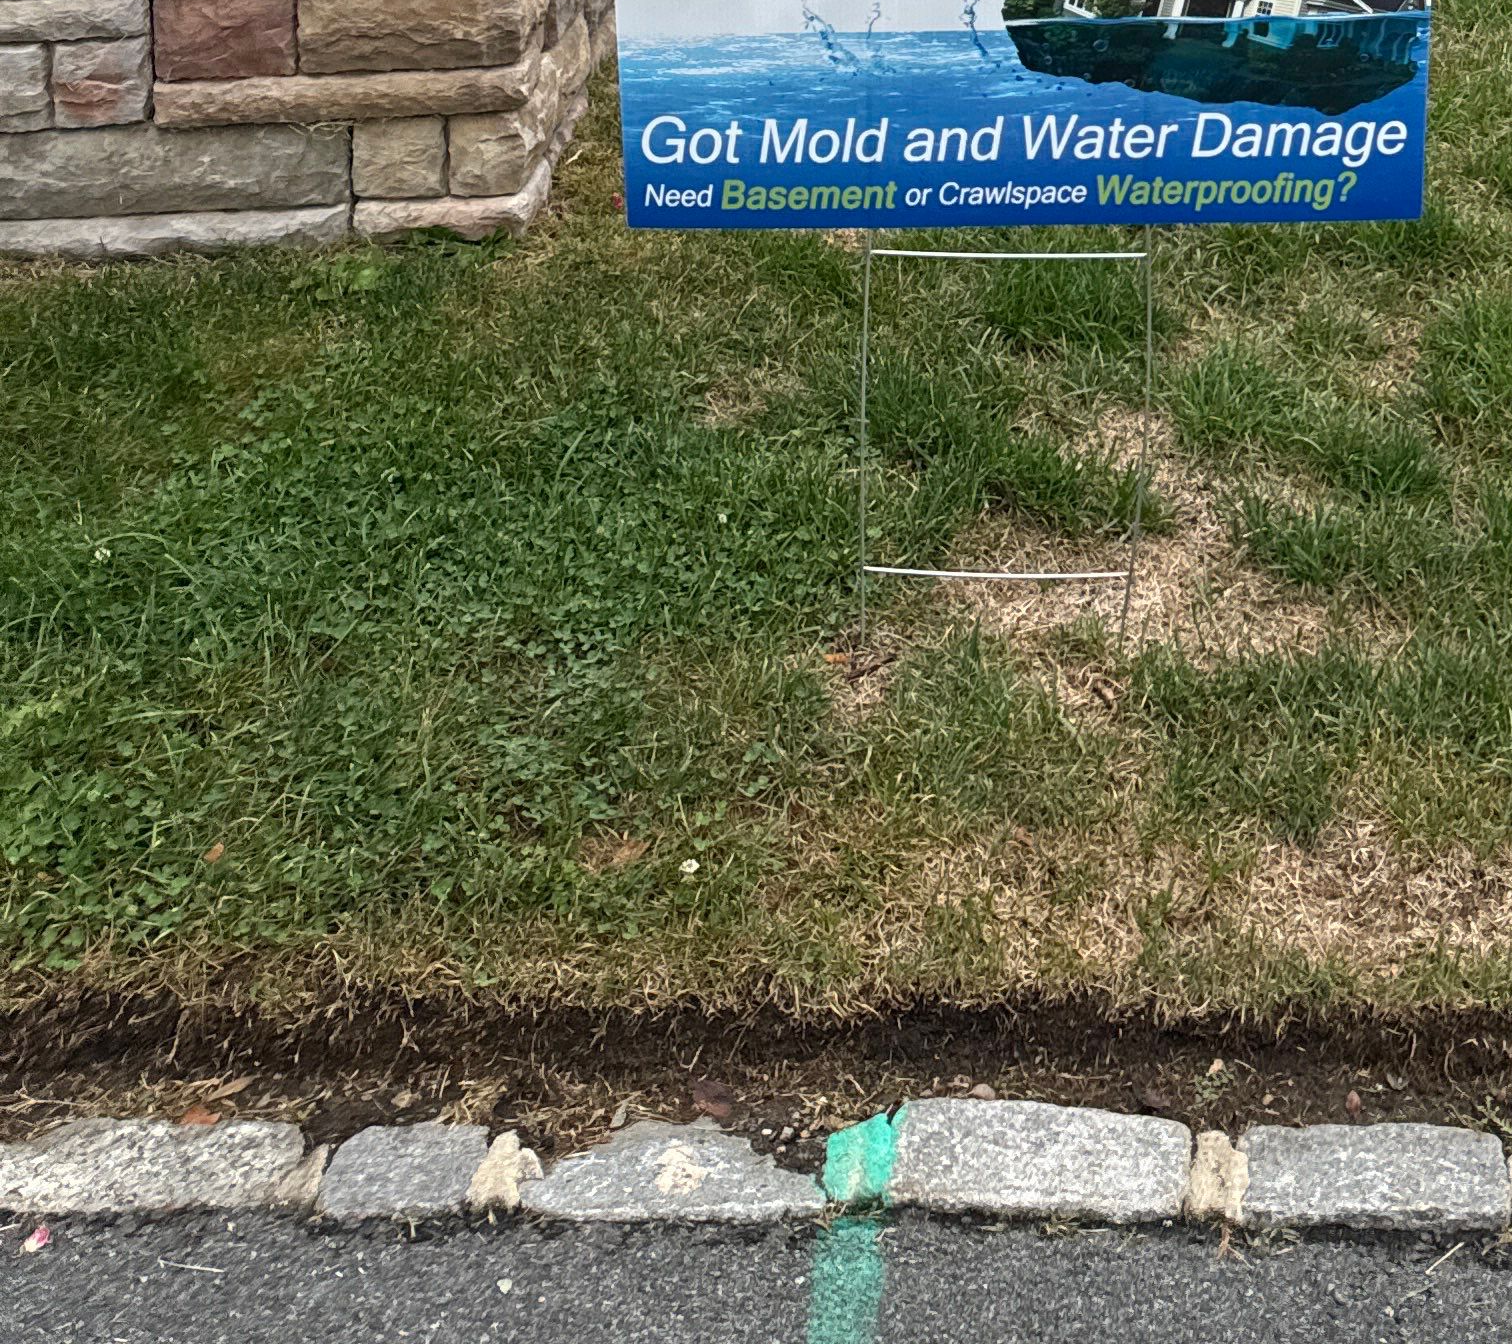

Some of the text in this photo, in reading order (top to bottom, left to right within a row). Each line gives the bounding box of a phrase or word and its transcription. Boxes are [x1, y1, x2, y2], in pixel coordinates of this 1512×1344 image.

[640, 111, 1408, 168] Got Mold and Water Damage
[643, 171, 1357, 212] Need Basement or Crawlspace Waterproofing?
